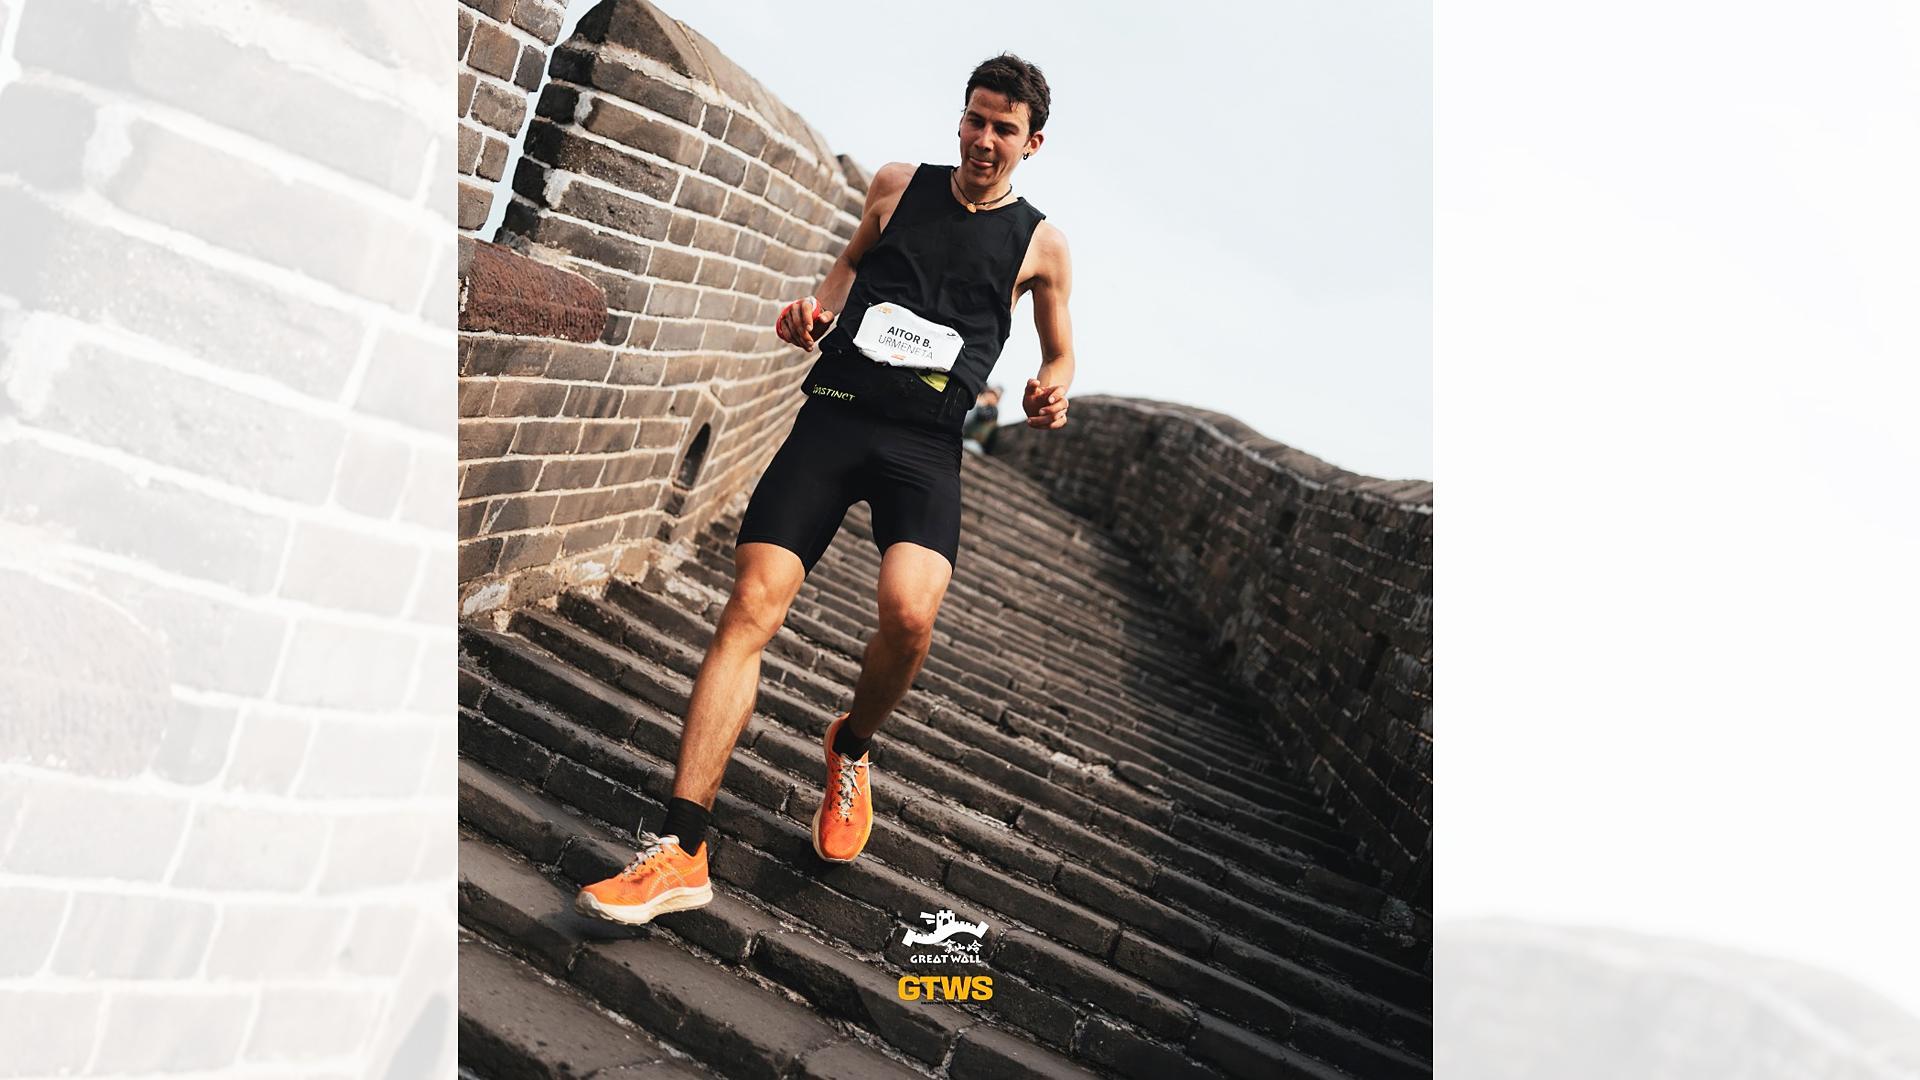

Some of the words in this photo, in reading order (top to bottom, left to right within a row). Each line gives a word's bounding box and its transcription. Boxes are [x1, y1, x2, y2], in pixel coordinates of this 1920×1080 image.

[878, 334, 933, 359] URMENETA
[887, 326, 921, 345] AITOR
[922, 338, 932, 349] B.
